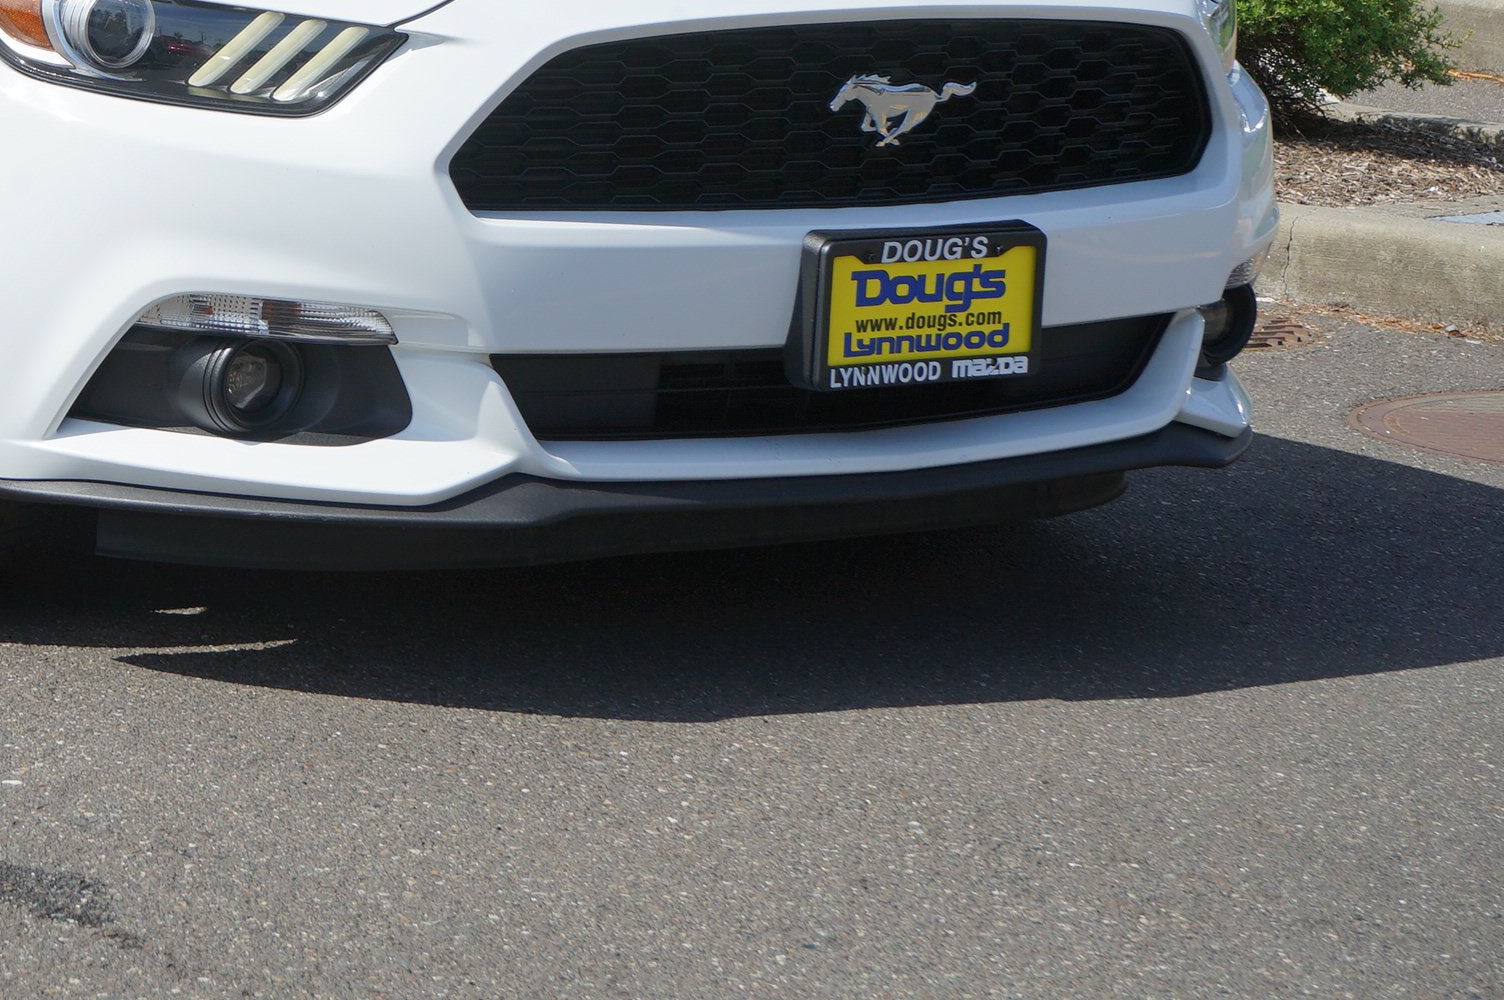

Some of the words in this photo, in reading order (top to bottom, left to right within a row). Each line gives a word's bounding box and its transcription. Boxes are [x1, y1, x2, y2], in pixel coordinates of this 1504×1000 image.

[881, 236, 989, 264] DOUG'S
[851, 263, 1007, 314] Doug's
[855, 310, 1003, 334] www.dougs.com
[842, 322, 1010, 359] Lynnwood
[829, 361, 942, 389] LYNNWOOD
